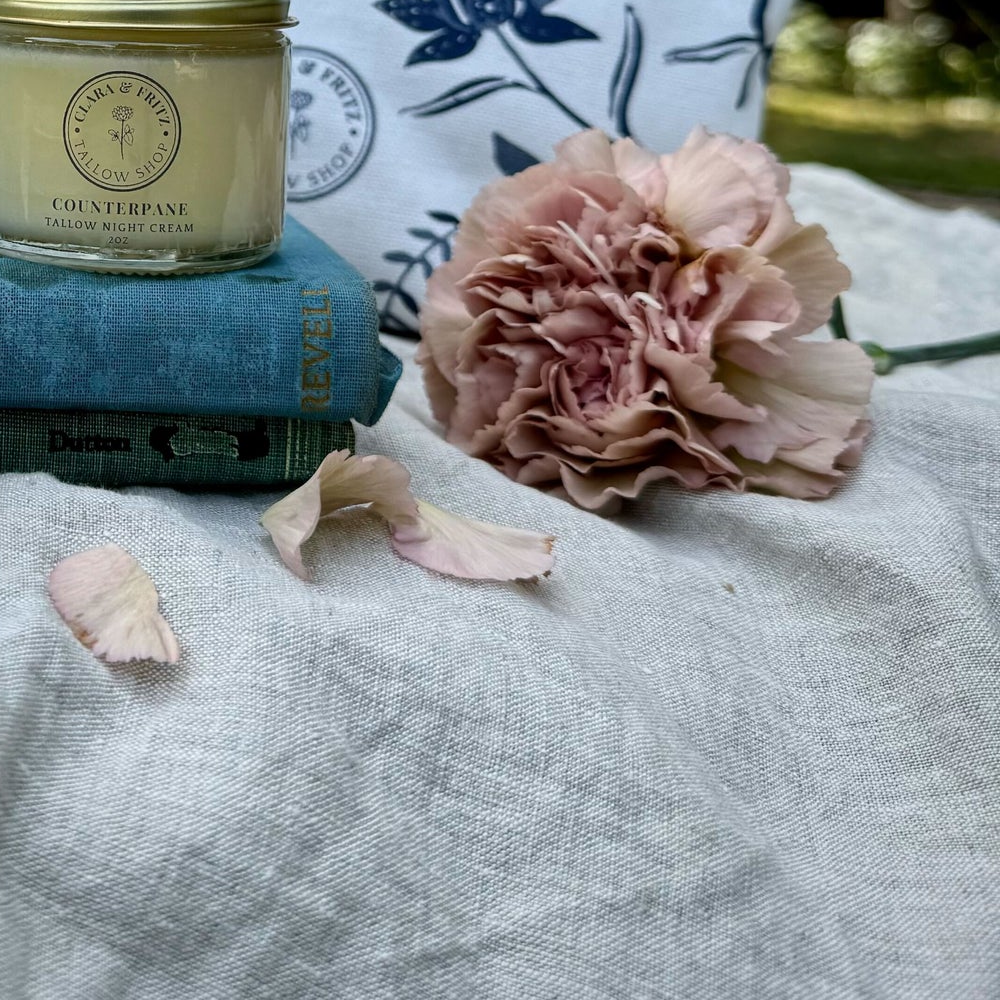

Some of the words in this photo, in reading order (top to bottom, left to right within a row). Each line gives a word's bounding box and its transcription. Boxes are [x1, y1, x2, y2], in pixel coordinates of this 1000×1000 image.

[74, 83, 114, 123] CLARA
[119, 81, 132, 93] &
[136, 85, 171, 126] FRITZ
[320, 67, 362, 122] FRITZ
[74, 139, 130, 183] TALLOW
[136, 143, 168, 179] SHOP
[307, 143, 354, 188] SHOP
[45, 217, 97, 231] TALLOW
[102, 222, 145, 232] NIGHT
[150, 223, 194, 233] CREAM
[52, 197, 188, 216] COUNTERPANE
[300, 285, 333, 413] REVELL
